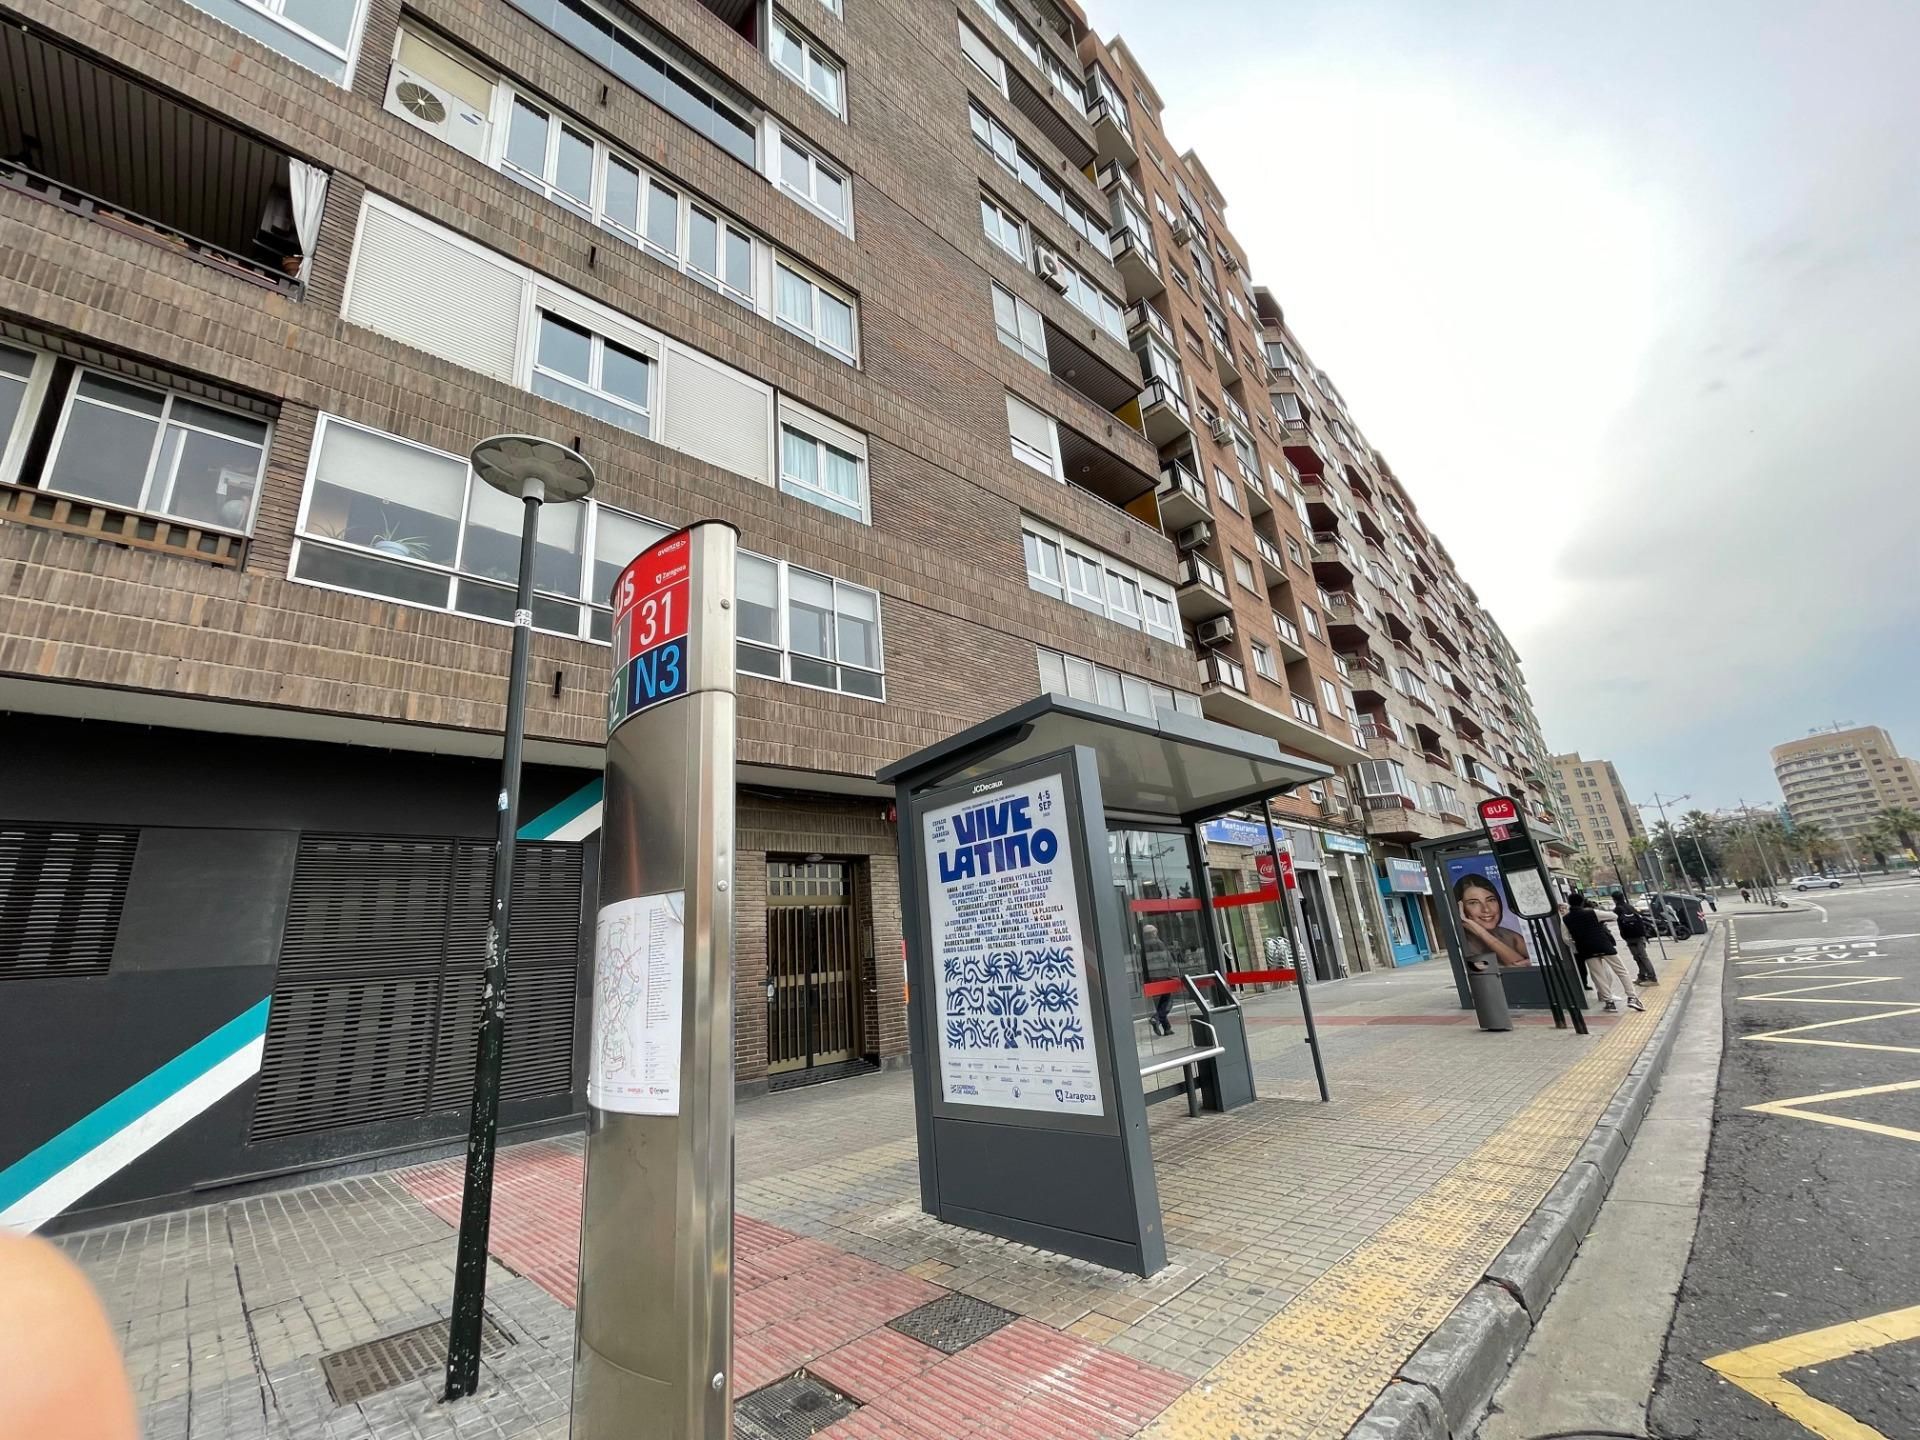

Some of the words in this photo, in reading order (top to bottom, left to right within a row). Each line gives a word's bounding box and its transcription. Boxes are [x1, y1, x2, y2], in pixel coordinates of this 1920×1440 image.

[614, 570, 635, 620] US
[640, 591, 672, 646] 31
[635, 644, 680, 705] N3
[972, 781, 1003, 795] JCDecaux
[1038, 800, 1052, 811] SEP
[1487, 803, 1508, 815] BUS
[952, 796, 1032, 846] VIVE
[939, 828, 1058, 883] LATINO
[1065, 1091, 1096, 1104] Zaragoza
